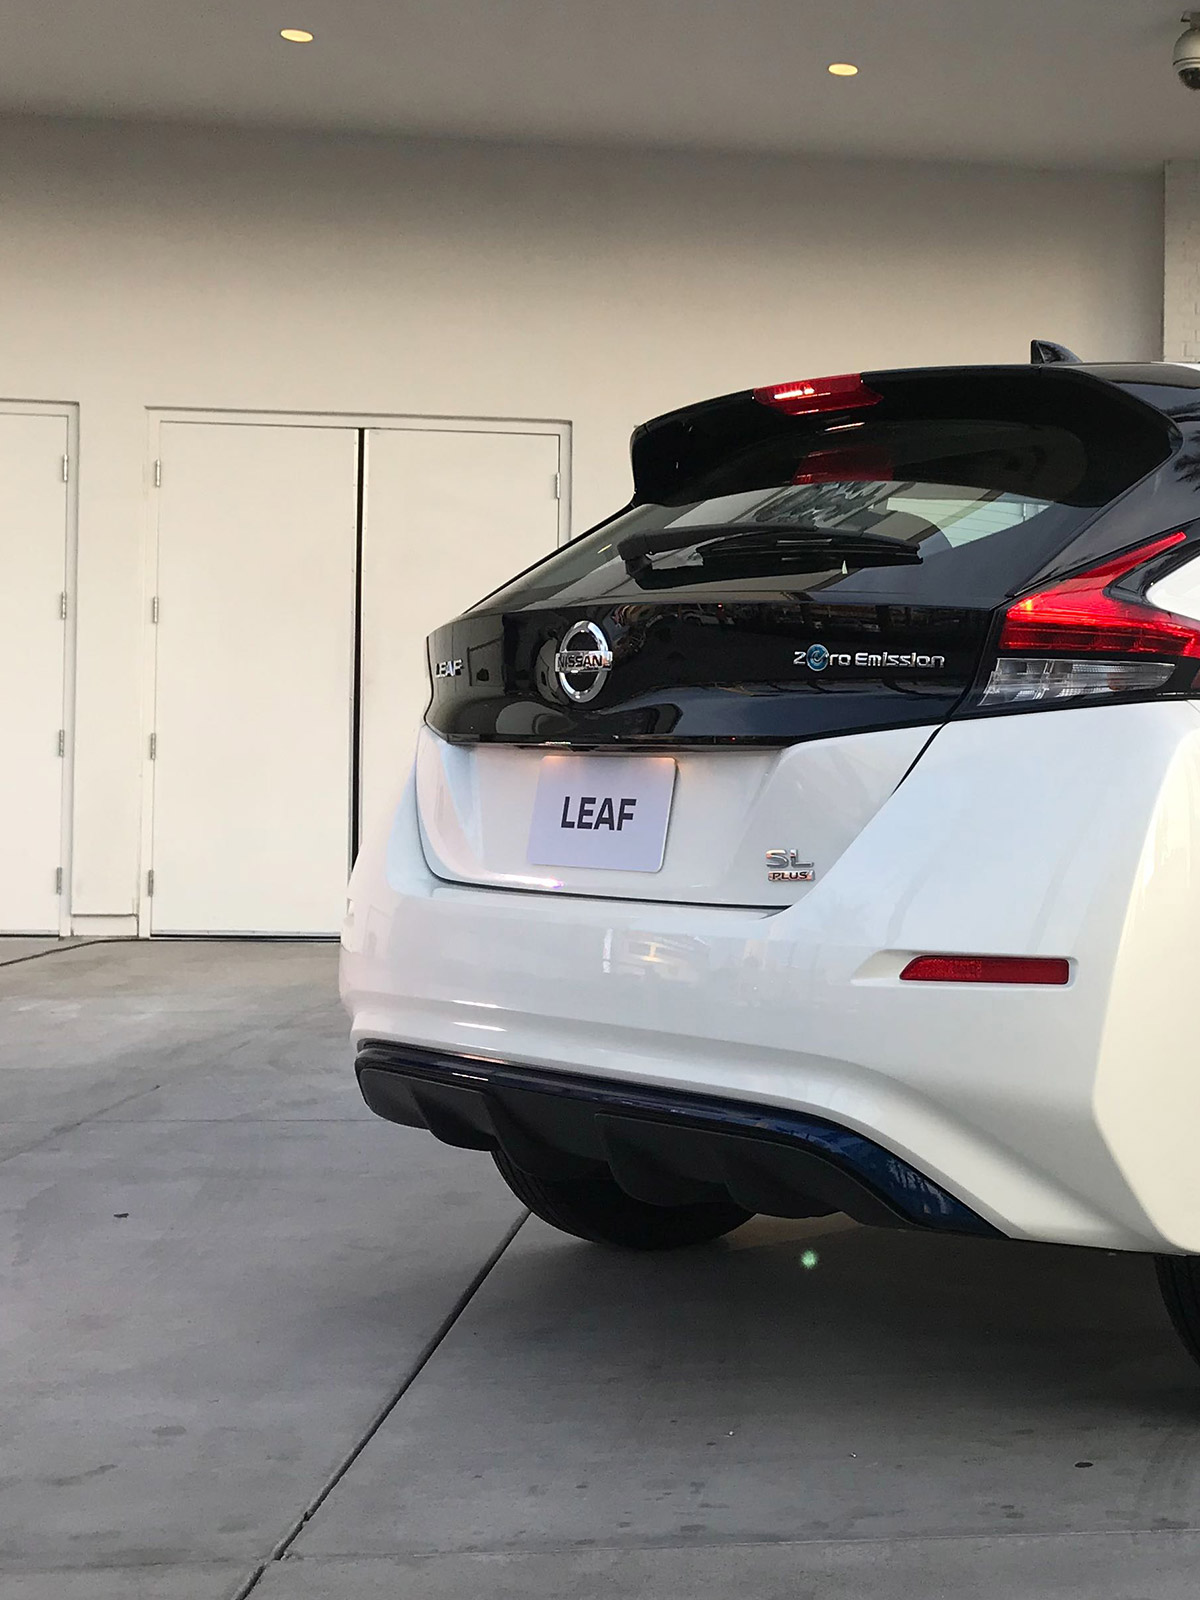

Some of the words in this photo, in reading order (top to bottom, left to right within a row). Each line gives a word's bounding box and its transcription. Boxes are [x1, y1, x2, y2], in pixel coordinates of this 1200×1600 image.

[435, 659, 462, 678] LEAF
[557, 653, 604, 669] NISSAN
[854, 651, 945, 668] Emission
[561, 796, 637, 831] LEAF
[765, 849, 815, 869] SL
[771, 871, 809, 881] PLUS
